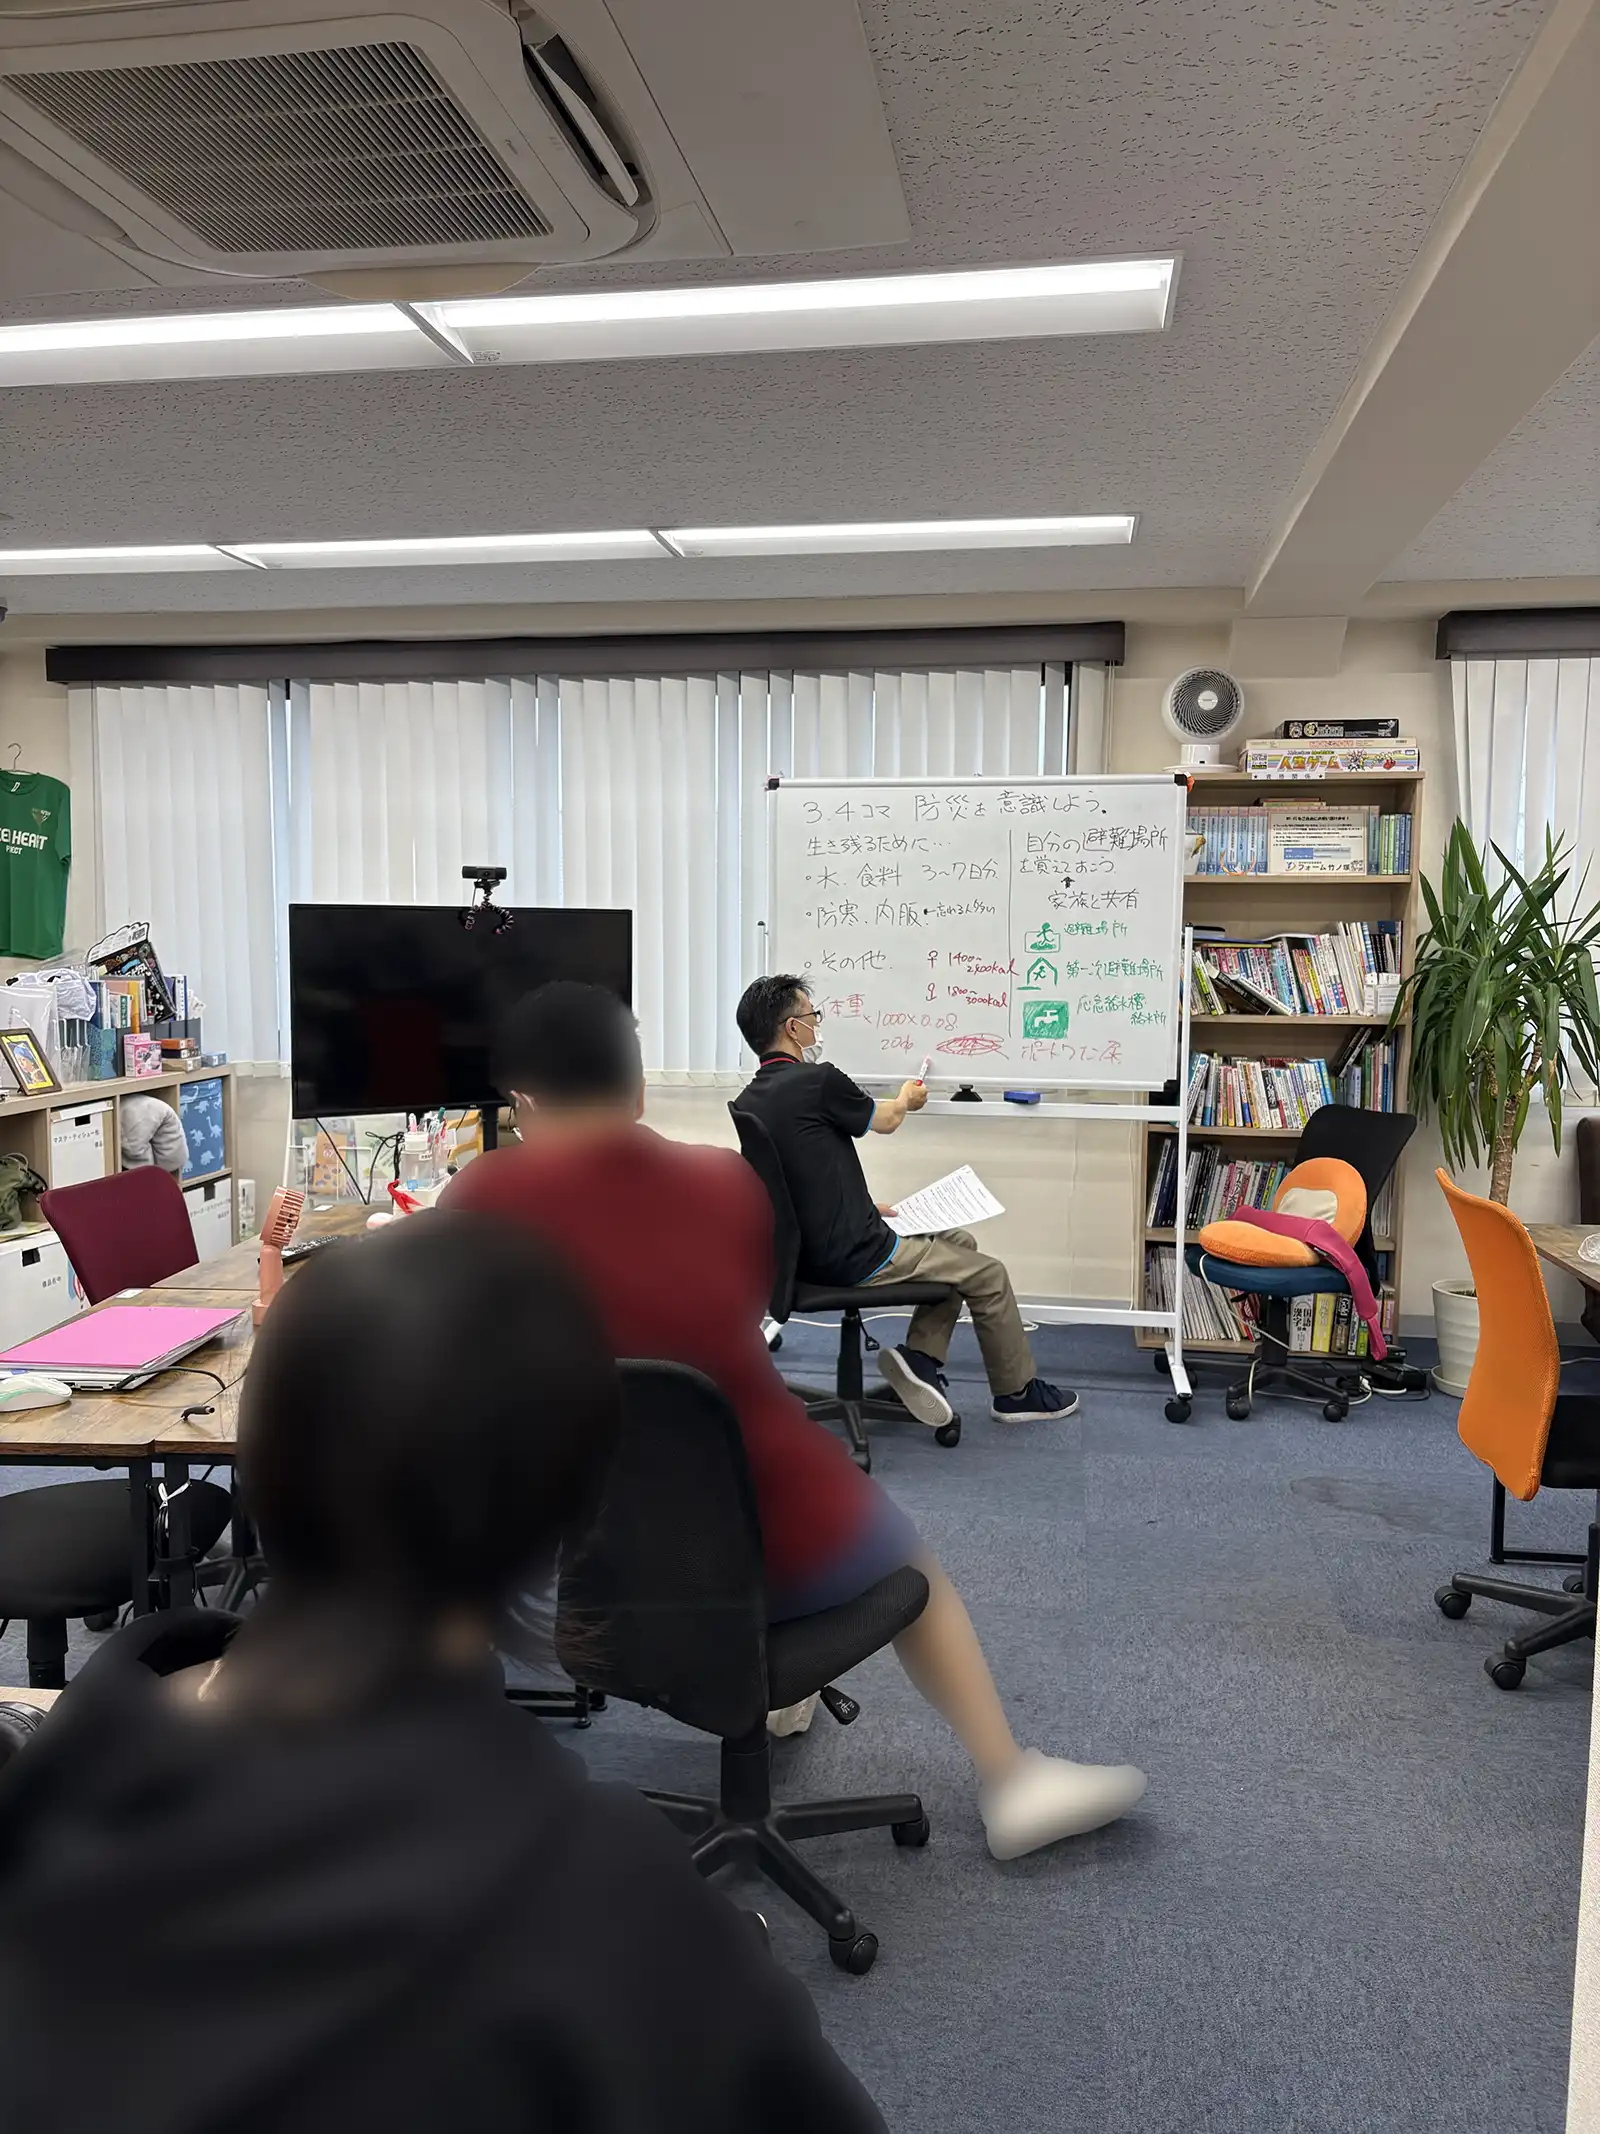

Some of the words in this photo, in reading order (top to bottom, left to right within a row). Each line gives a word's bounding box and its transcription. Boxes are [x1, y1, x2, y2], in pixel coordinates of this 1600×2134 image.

[1278, 755, 1344, 772] 人生ゲーム
[1026, 824, 1168, 853] 自分の避難場所
[1048, 888, 1140, 910] 家族と共有
